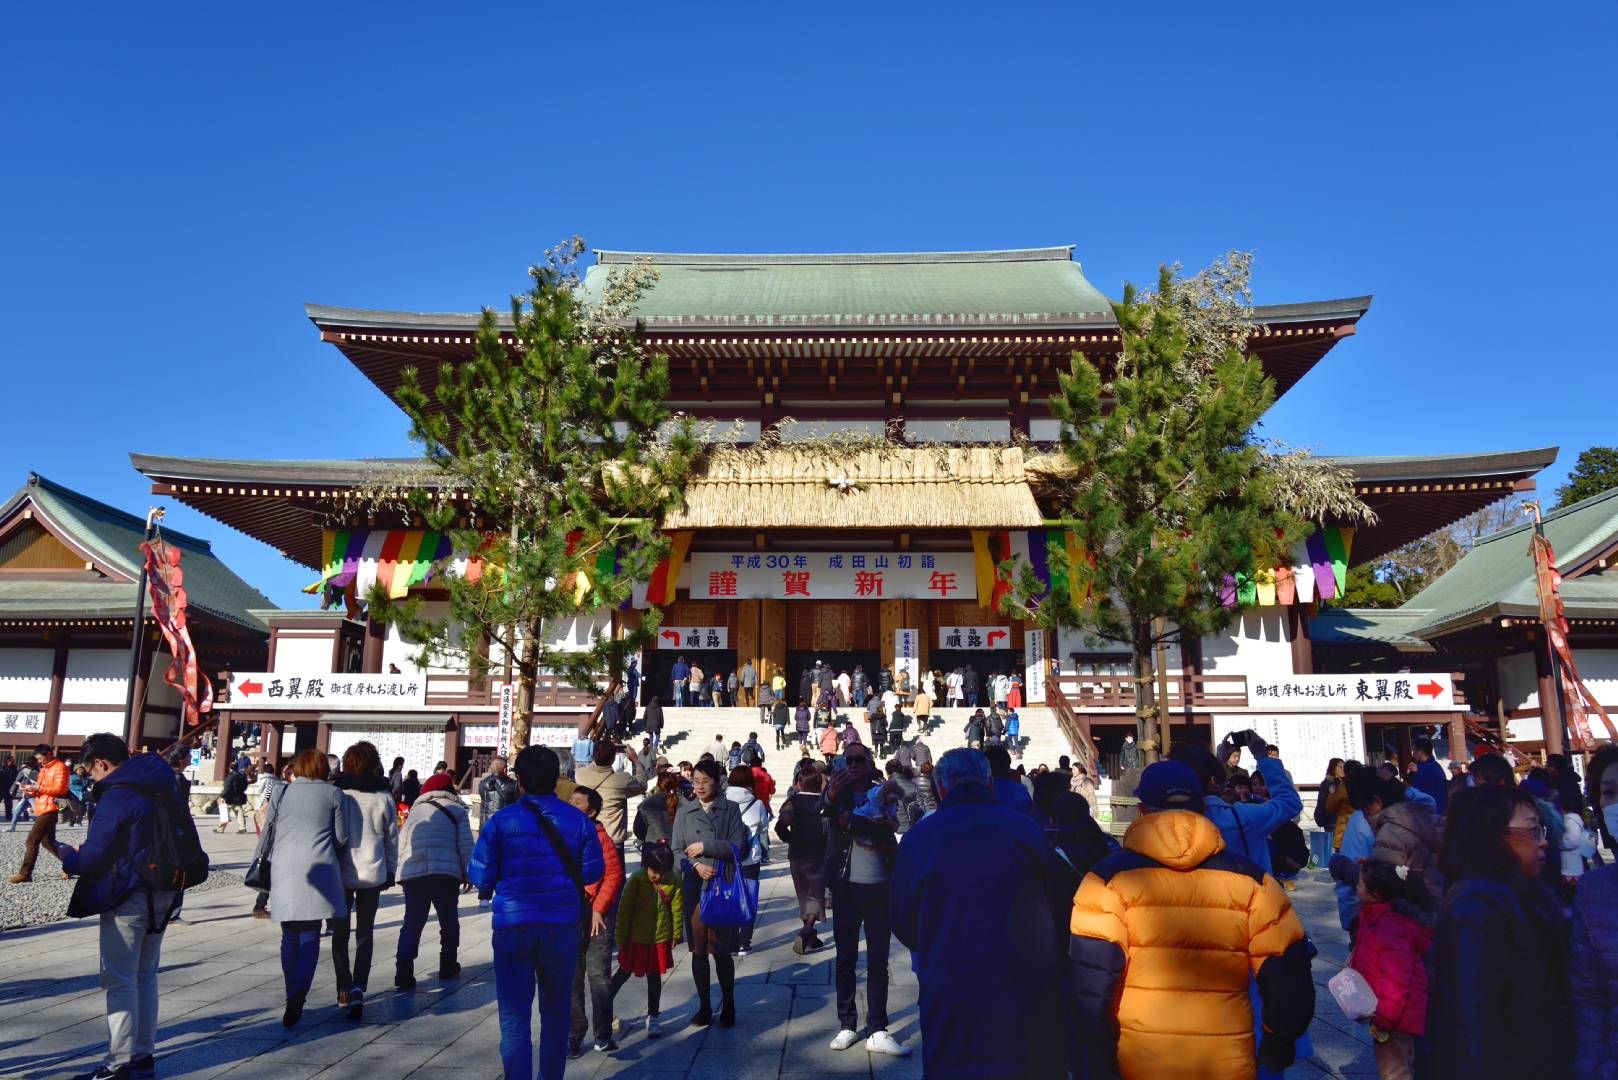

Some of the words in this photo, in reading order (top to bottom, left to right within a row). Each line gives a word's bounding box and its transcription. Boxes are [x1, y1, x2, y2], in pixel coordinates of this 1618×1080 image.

[731, 555, 808, 569] 平成30年
[828, 555, 935, 569] 成田山初詣
[708, 571, 958, 597] 謹賀新年
[686, 635, 720, 648] 順路
[946, 635, 983, 648] 順路
[267, 677, 325, 700] 西翼殿
[330, 682, 419, 697] 御護摩札お渡し所
[1255, 683, 1348, 698] 御護摩札お渡し所
[1355, 678, 1415, 701] 東翼殿
